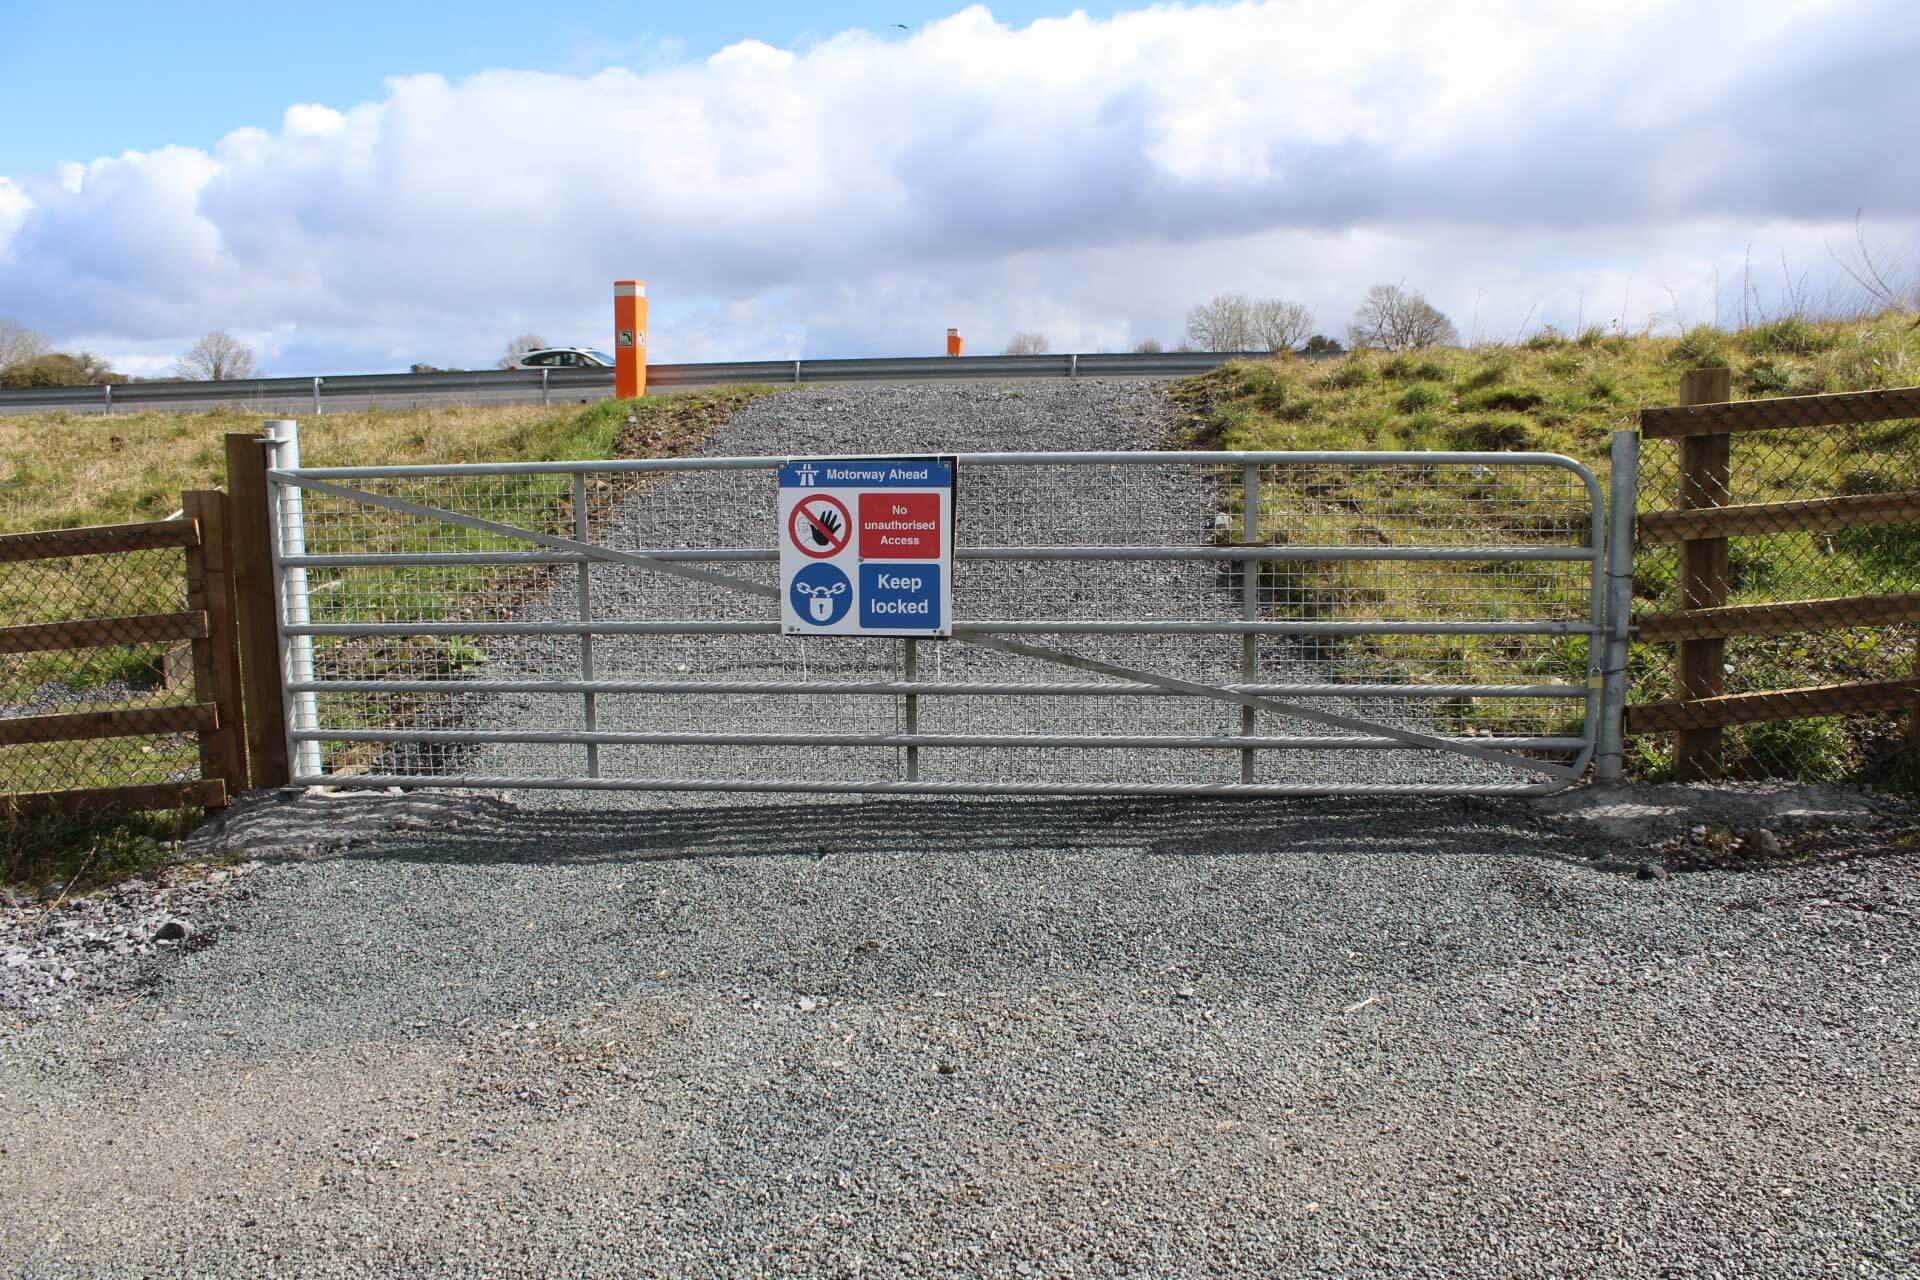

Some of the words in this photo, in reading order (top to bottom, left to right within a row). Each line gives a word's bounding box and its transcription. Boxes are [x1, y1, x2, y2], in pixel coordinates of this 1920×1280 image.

[827, 469, 885, 482] Motorway
[889, 468, 928, 480] Ahead
[892, 505, 908, 515] No
[864, 519, 936, 530] unauthorised
[880, 535, 920, 545] Access
[878, 573, 922, 593] Keep
[871, 598, 929, 614] locked
